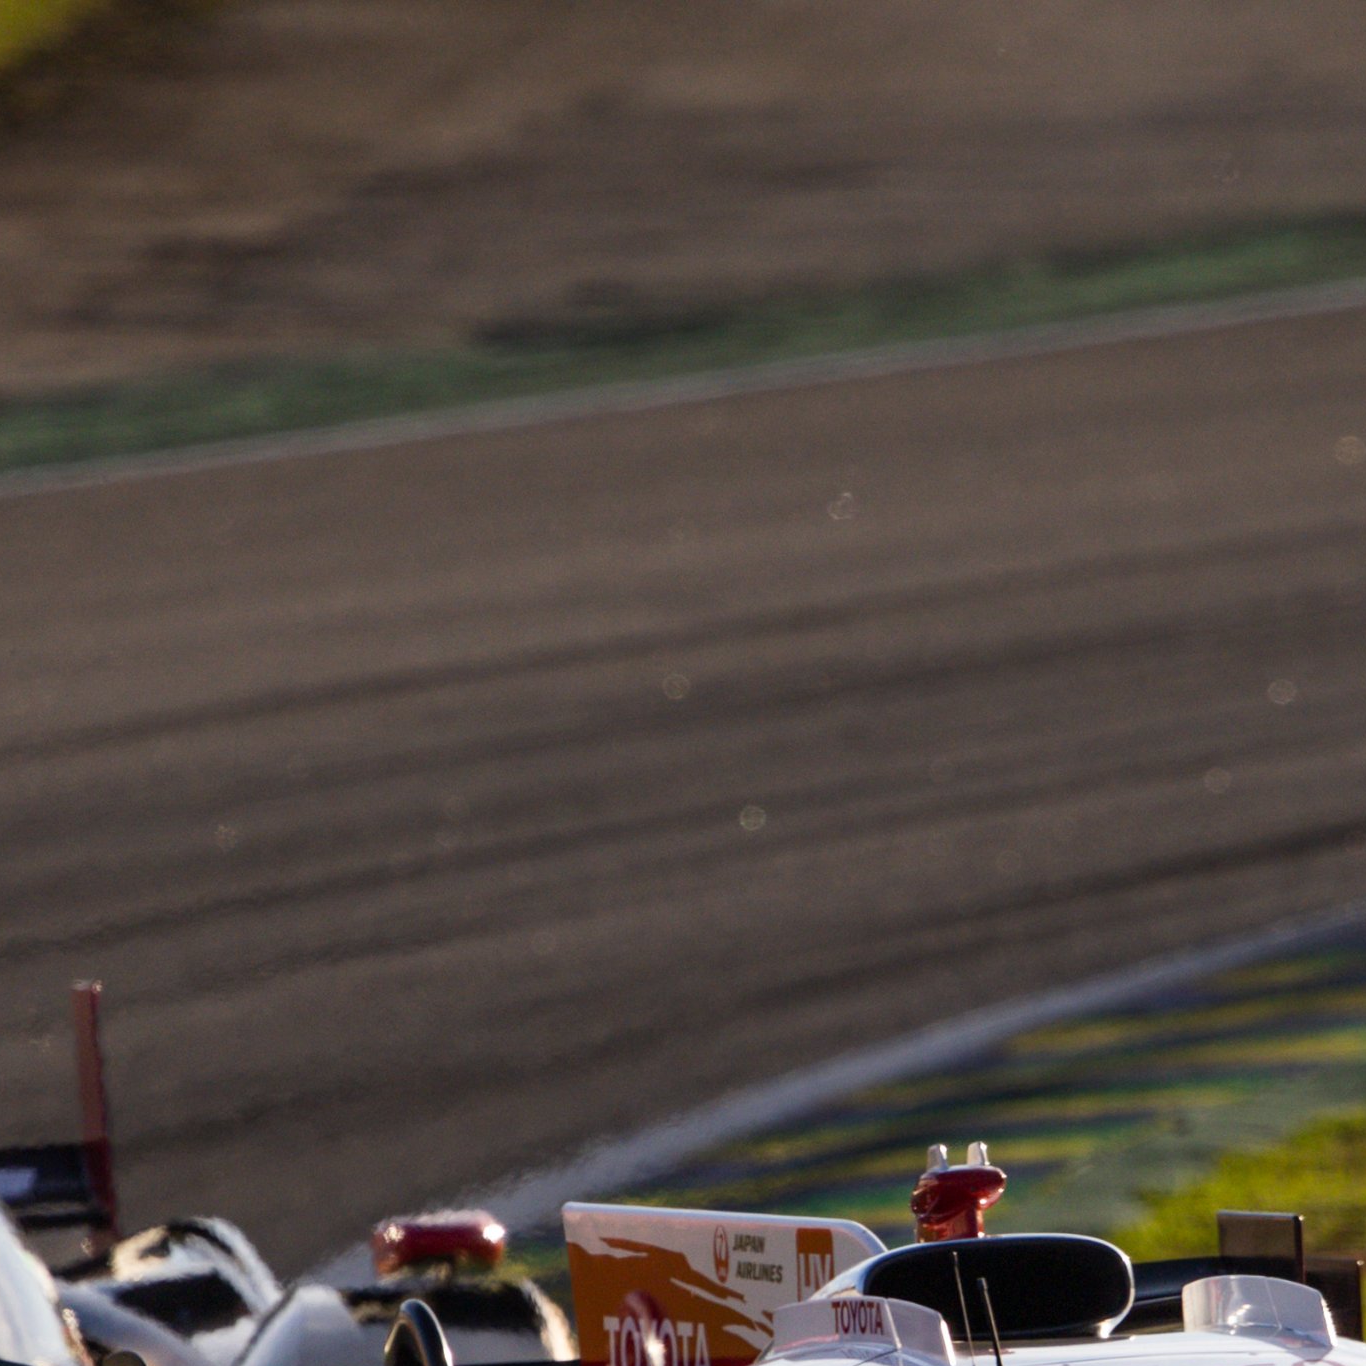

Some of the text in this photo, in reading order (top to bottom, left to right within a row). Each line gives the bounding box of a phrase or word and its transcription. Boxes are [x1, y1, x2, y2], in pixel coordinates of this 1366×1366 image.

[732, 1233, 766, 1254] JAPAN
[736, 1260, 784, 1284] AIRLINES
[831, 1301, 884, 1336] TOYOTA
